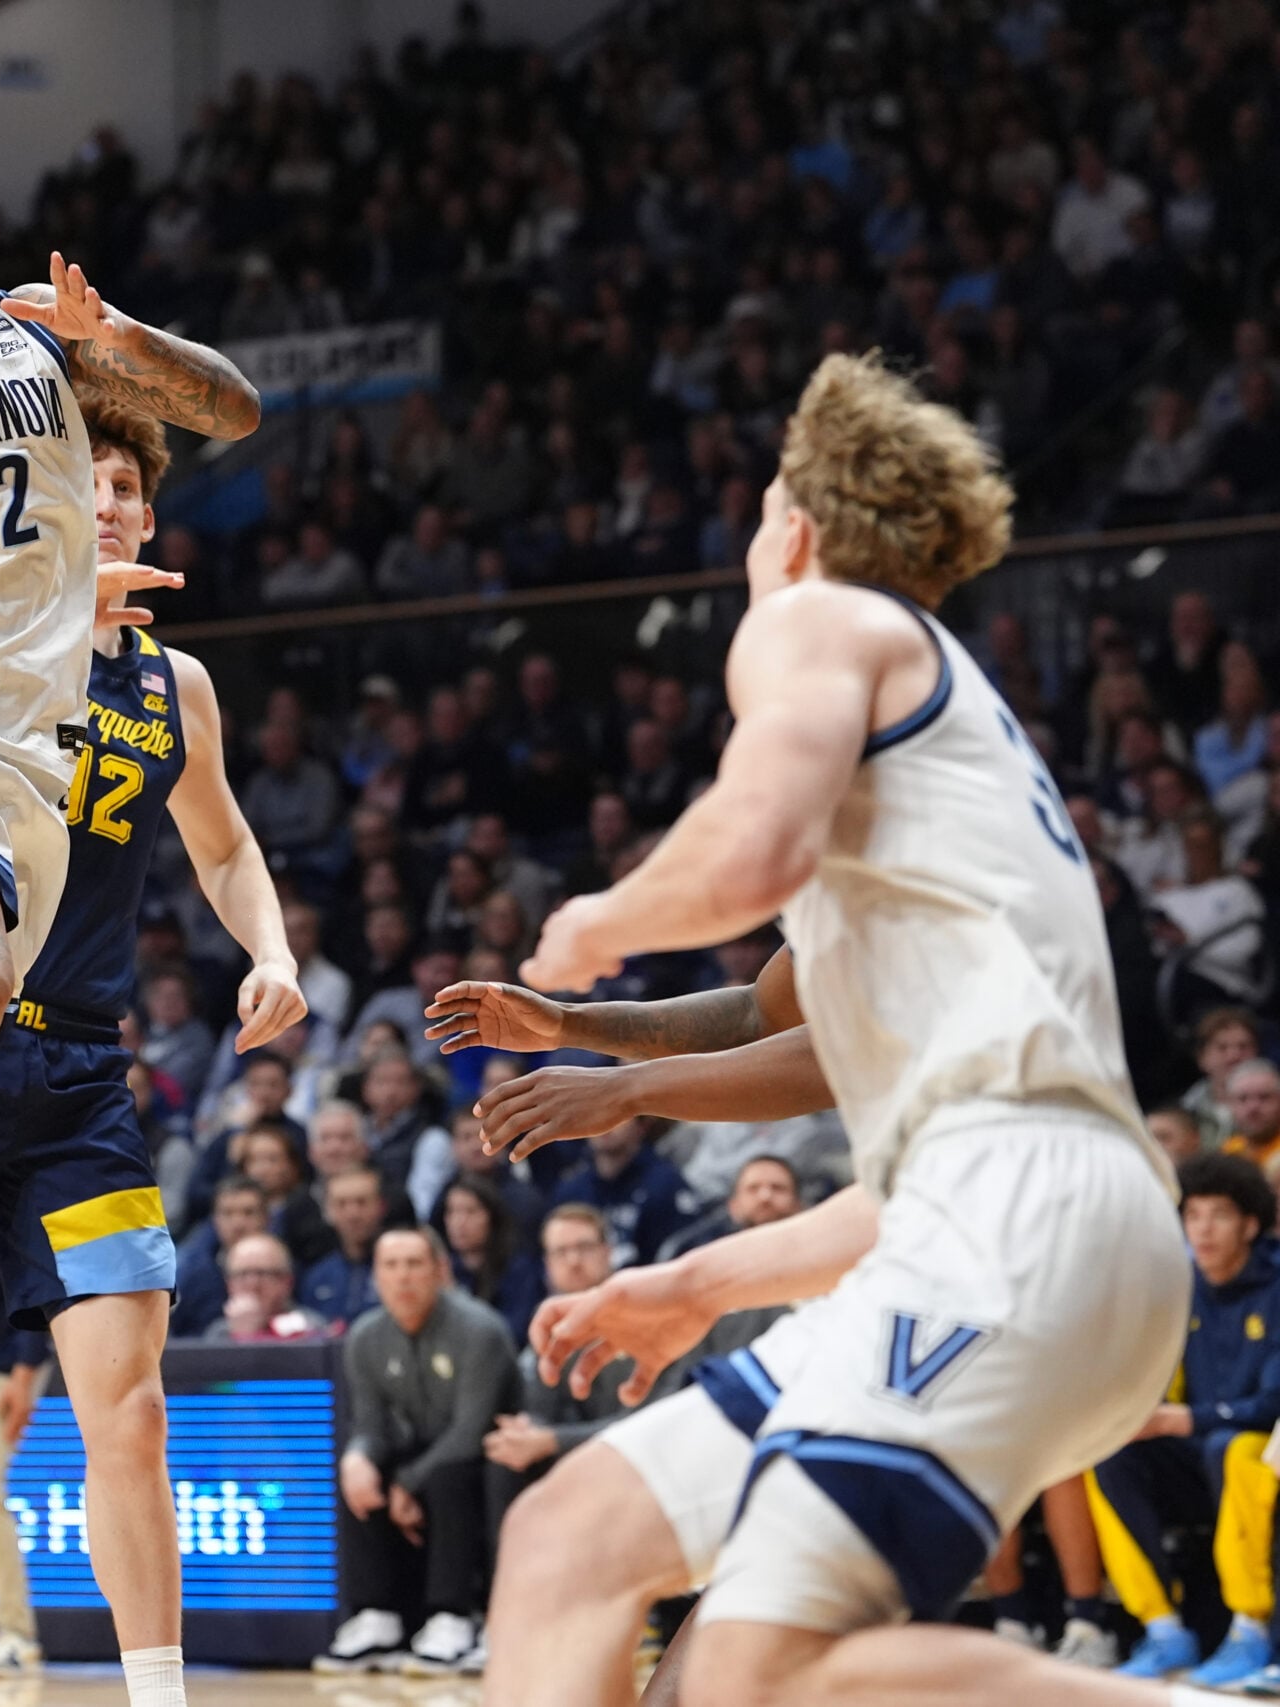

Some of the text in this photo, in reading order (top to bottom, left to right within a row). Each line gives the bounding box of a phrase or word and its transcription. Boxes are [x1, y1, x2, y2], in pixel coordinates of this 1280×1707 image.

[87, 699, 175, 760] rquette
[16, 999, 48, 1036] AL
[880, 1311, 994, 1404] V
[47, 1481, 266, 1555] Hlth
